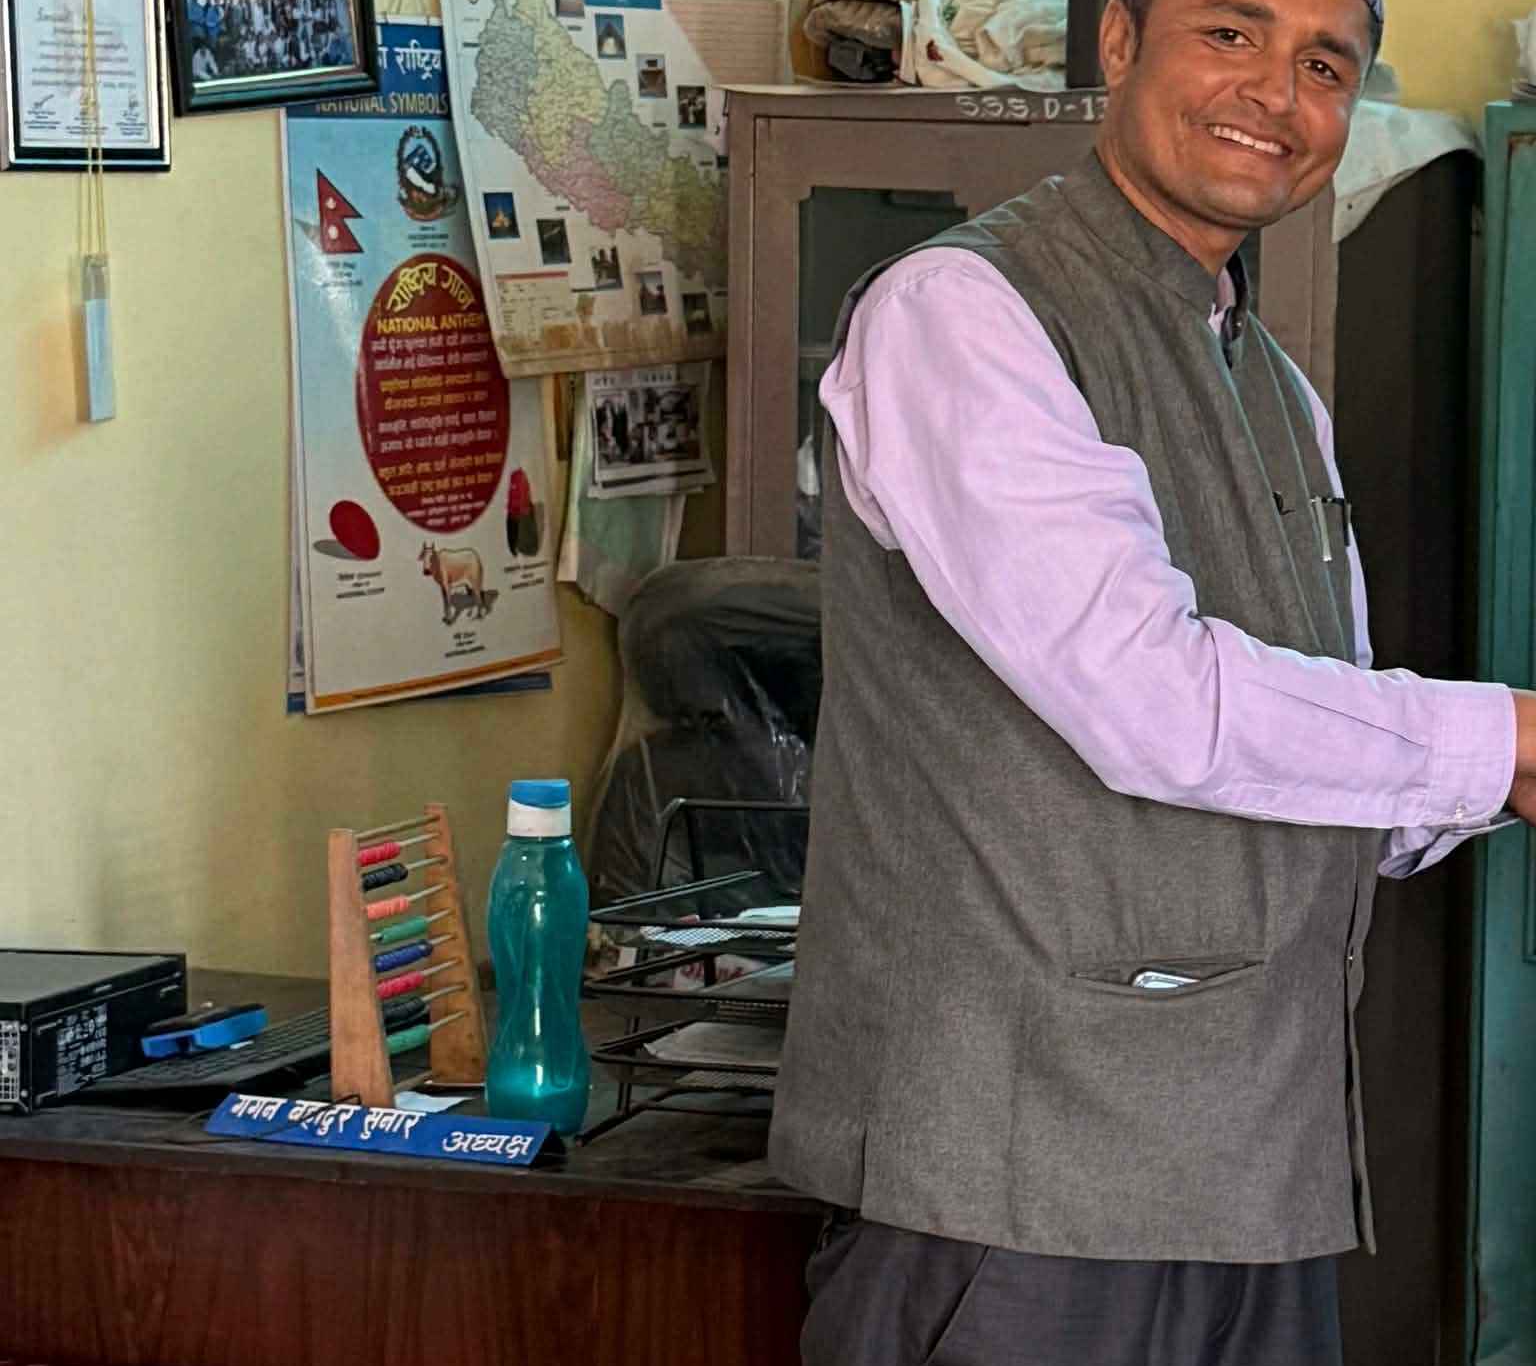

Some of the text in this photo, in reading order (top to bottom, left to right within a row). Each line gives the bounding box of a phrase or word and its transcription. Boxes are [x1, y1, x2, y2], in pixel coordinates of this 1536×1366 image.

[389, 91, 449, 115] SYMBOLS
[377, 315, 438, 335] NATIONAL
[231, 1094, 287, 1121] गगन
[360, 1107, 427, 1140] सुनार
[441, 1129, 534, 1160] अध्यक्ष
